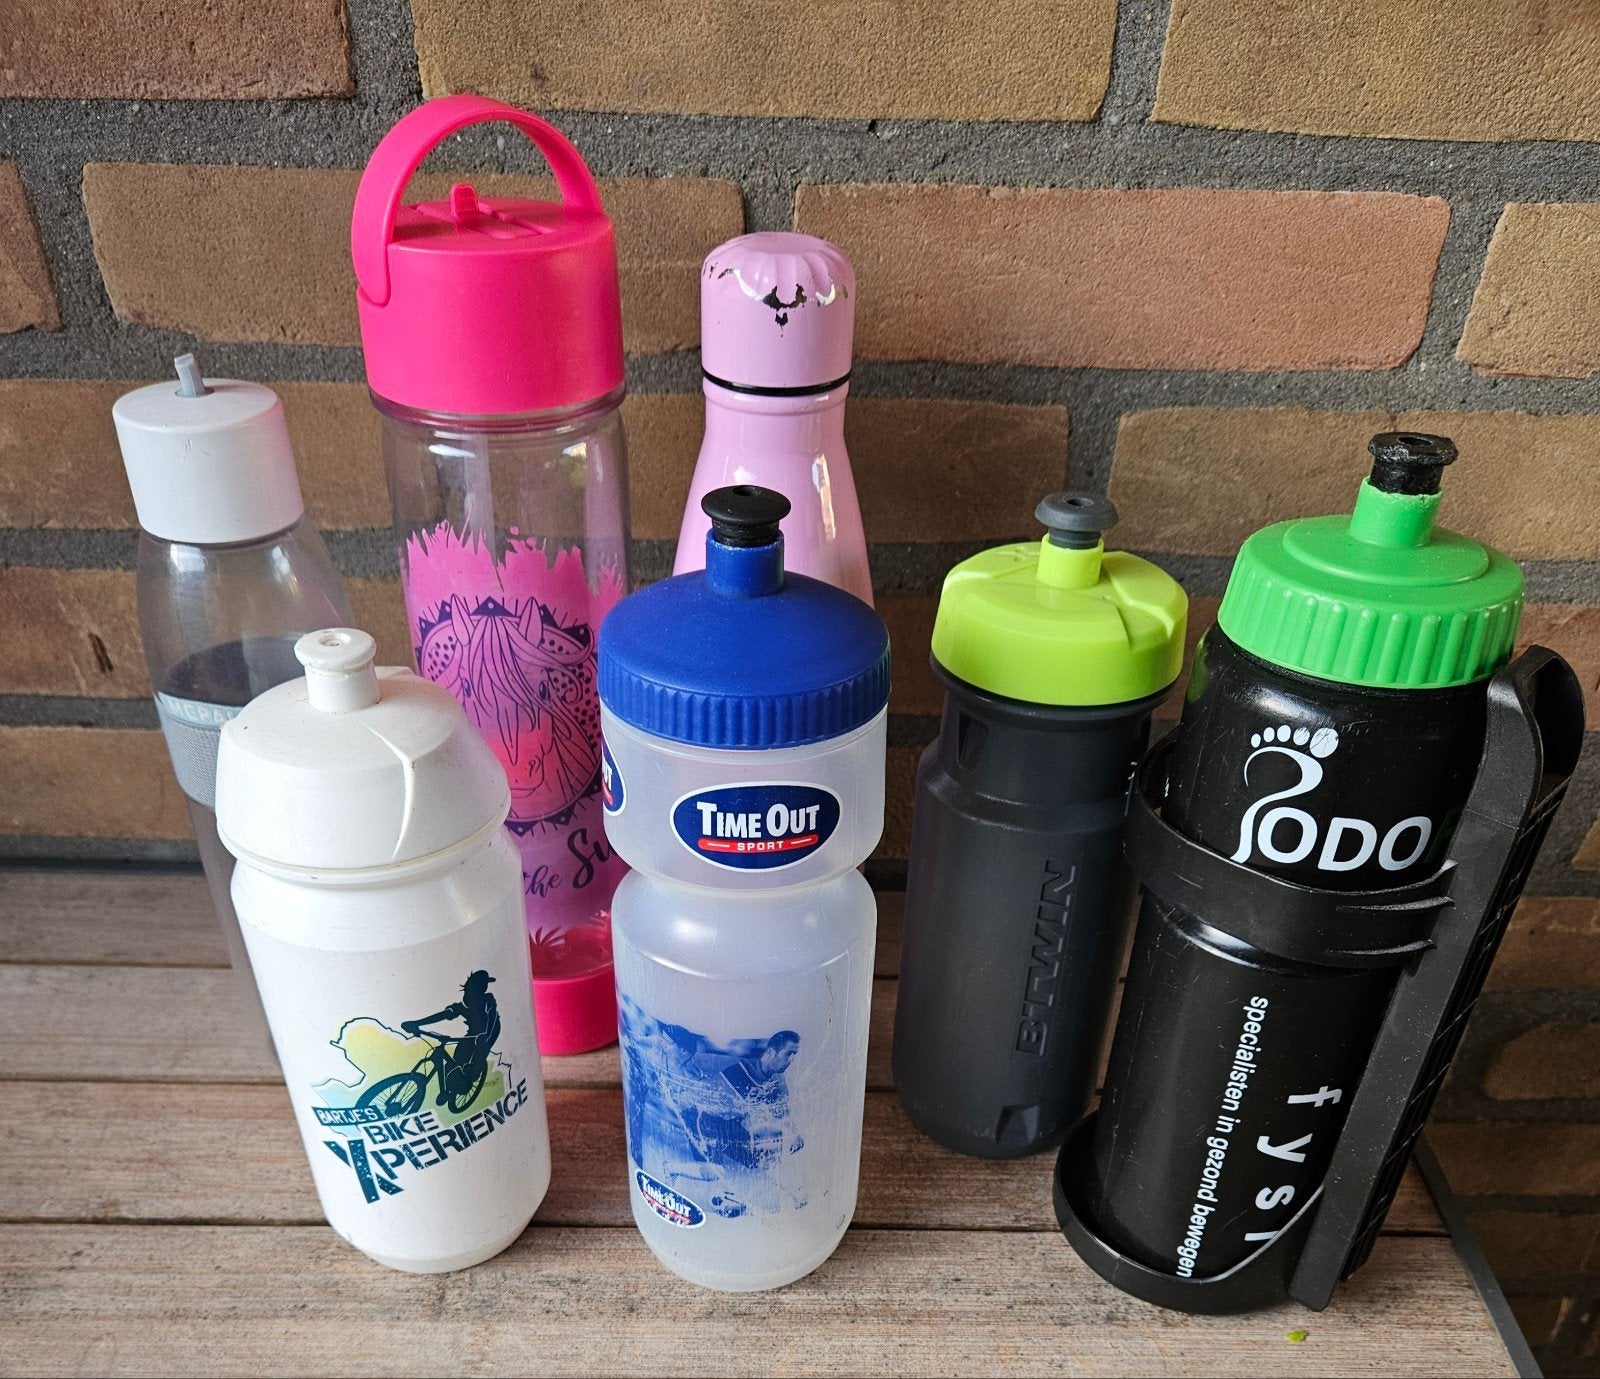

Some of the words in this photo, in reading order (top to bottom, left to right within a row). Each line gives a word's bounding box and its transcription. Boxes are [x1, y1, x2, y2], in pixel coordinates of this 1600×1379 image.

[737, 841, 784, 851] SPORT
[1221, 995, 1269, 1111] specialisten
[316, 1107, 379, 1124] BARTJE'S
[363, 1111, 440, 1145] BIKE
[1215, 1115, 1242, 1133] in
[1197, 1136, 1229, 1203] gezond
[1176, 1203, 1216, 1278] bewegen
